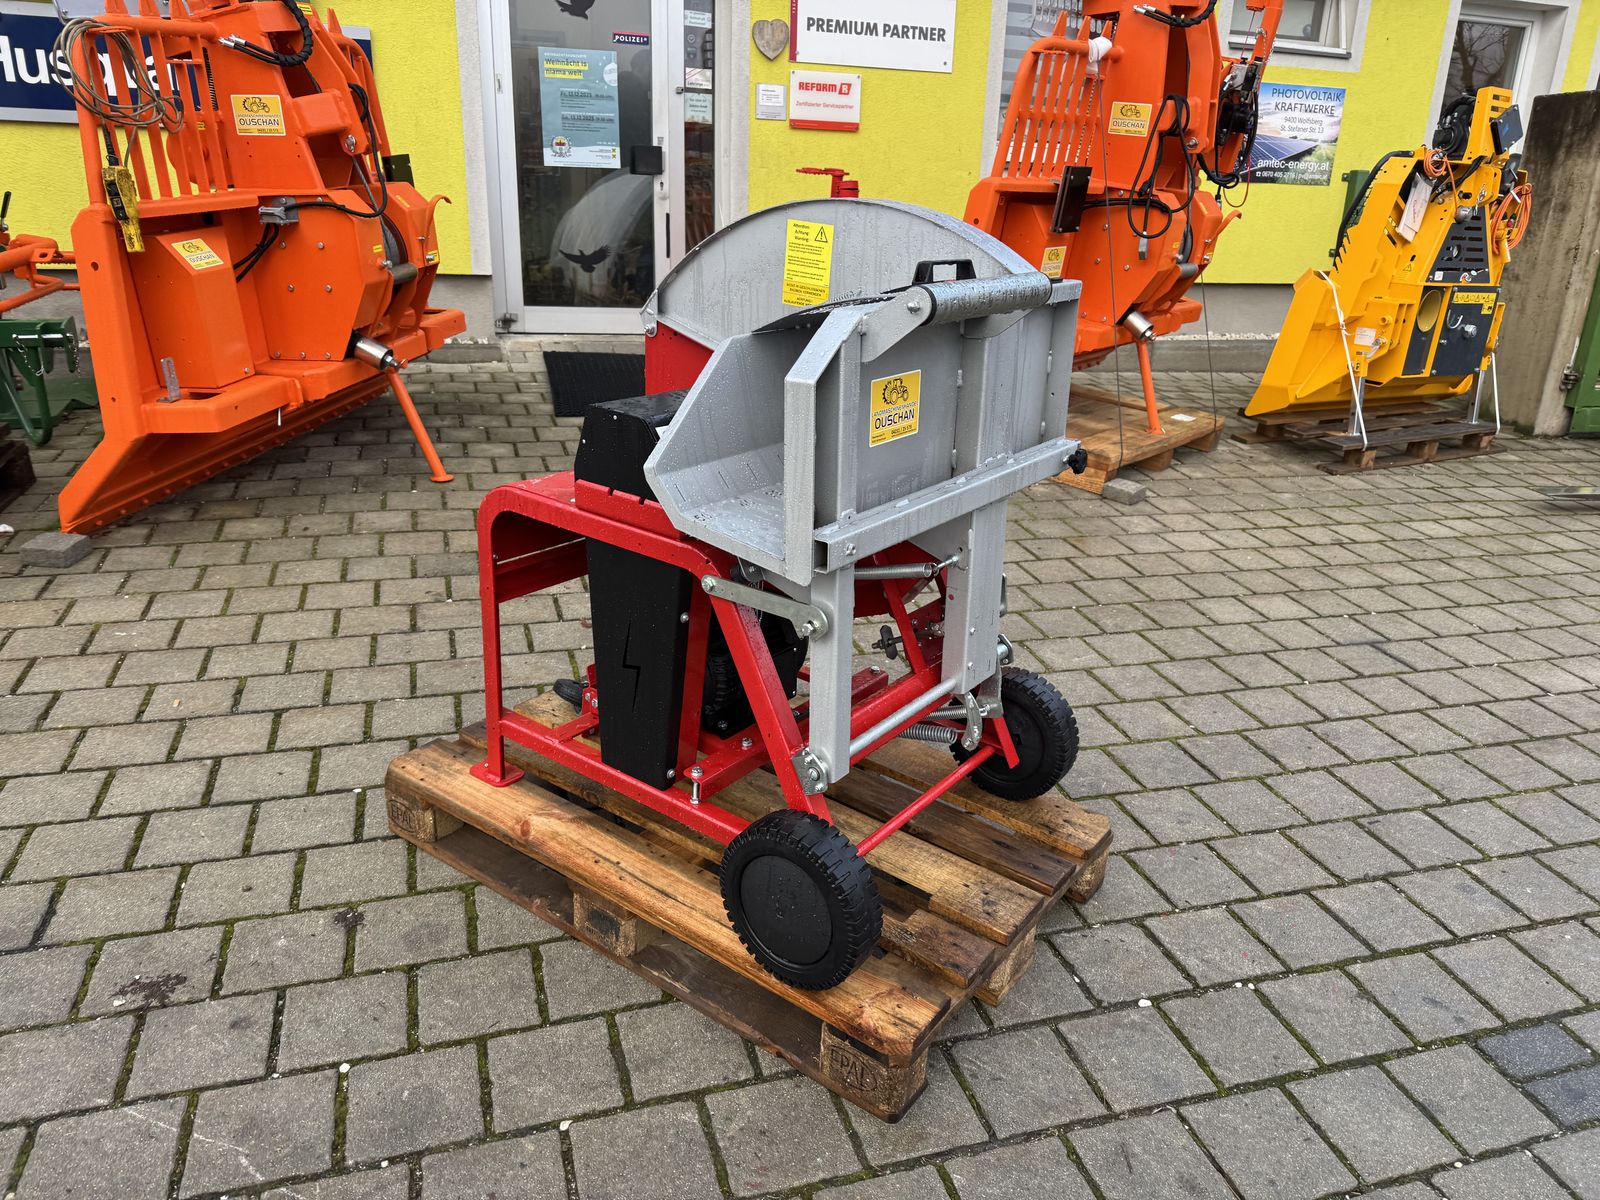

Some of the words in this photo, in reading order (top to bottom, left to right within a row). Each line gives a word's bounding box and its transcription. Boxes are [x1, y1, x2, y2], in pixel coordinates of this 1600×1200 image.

[806, 16, 879, 37] PREMIUM
[882, 23, 947, 42] PARTNER
[614, 35, 643, 43] POLIZEI
[798, 81, 837, 93] REFORM
[1271, 88, 1342, 102] PHOTOVOLTAIK
[822, 102, 854, 110] Servicepartner
[1274, 101, 1336, 115] KRAFTWERKE
[238, 118, 280, 126] OUSCHAN
[1284, 116, 1297, 124] 9400
[1297, 117, 1323, 127] Wolfsberg
[1257, 159, 1330, 172] amtec-energy.at
[875, 408, 914, 429] OUSCHAN
[830, 1048, 869, 1087] EPAL
